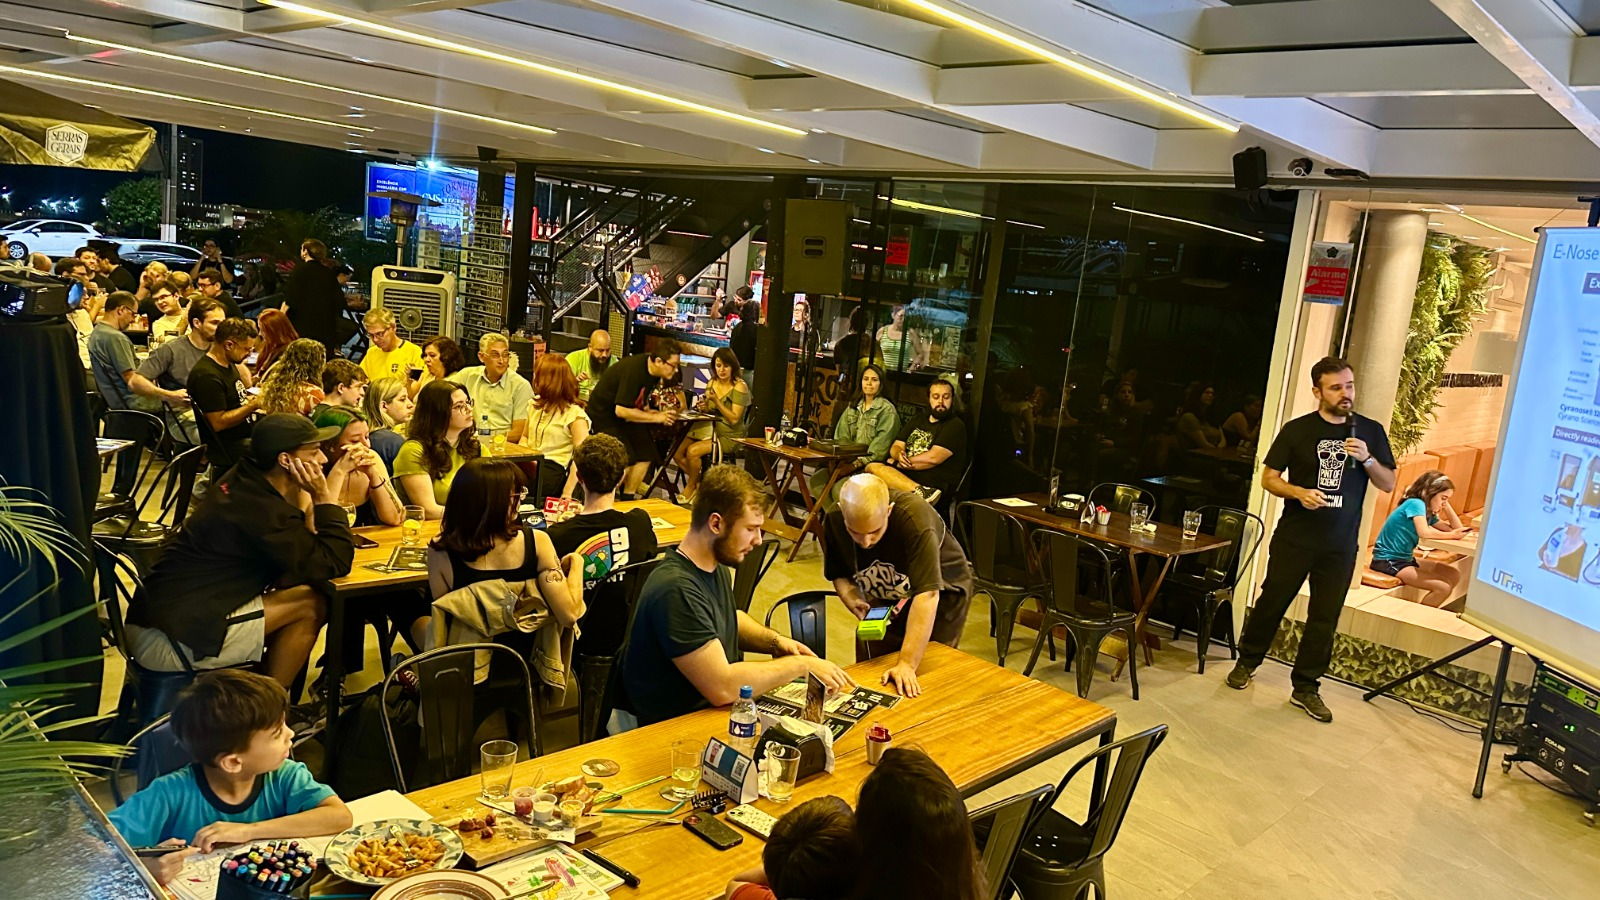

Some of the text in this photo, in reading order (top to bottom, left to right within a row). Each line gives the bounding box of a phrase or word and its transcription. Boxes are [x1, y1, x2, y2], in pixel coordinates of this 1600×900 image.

[51, 131, 83, 143] SERRAS
[51, 142, 81, 154] GERAIS
[1553, 244, 1600, 260] E-Nose
[1311, 269, 1347, 279] Alarme
[1555, 429, 1580, 441] Directly
[1321, 469, 1341, 478] PINT OF
[1492, 567, 1523, 594] UTFPR
